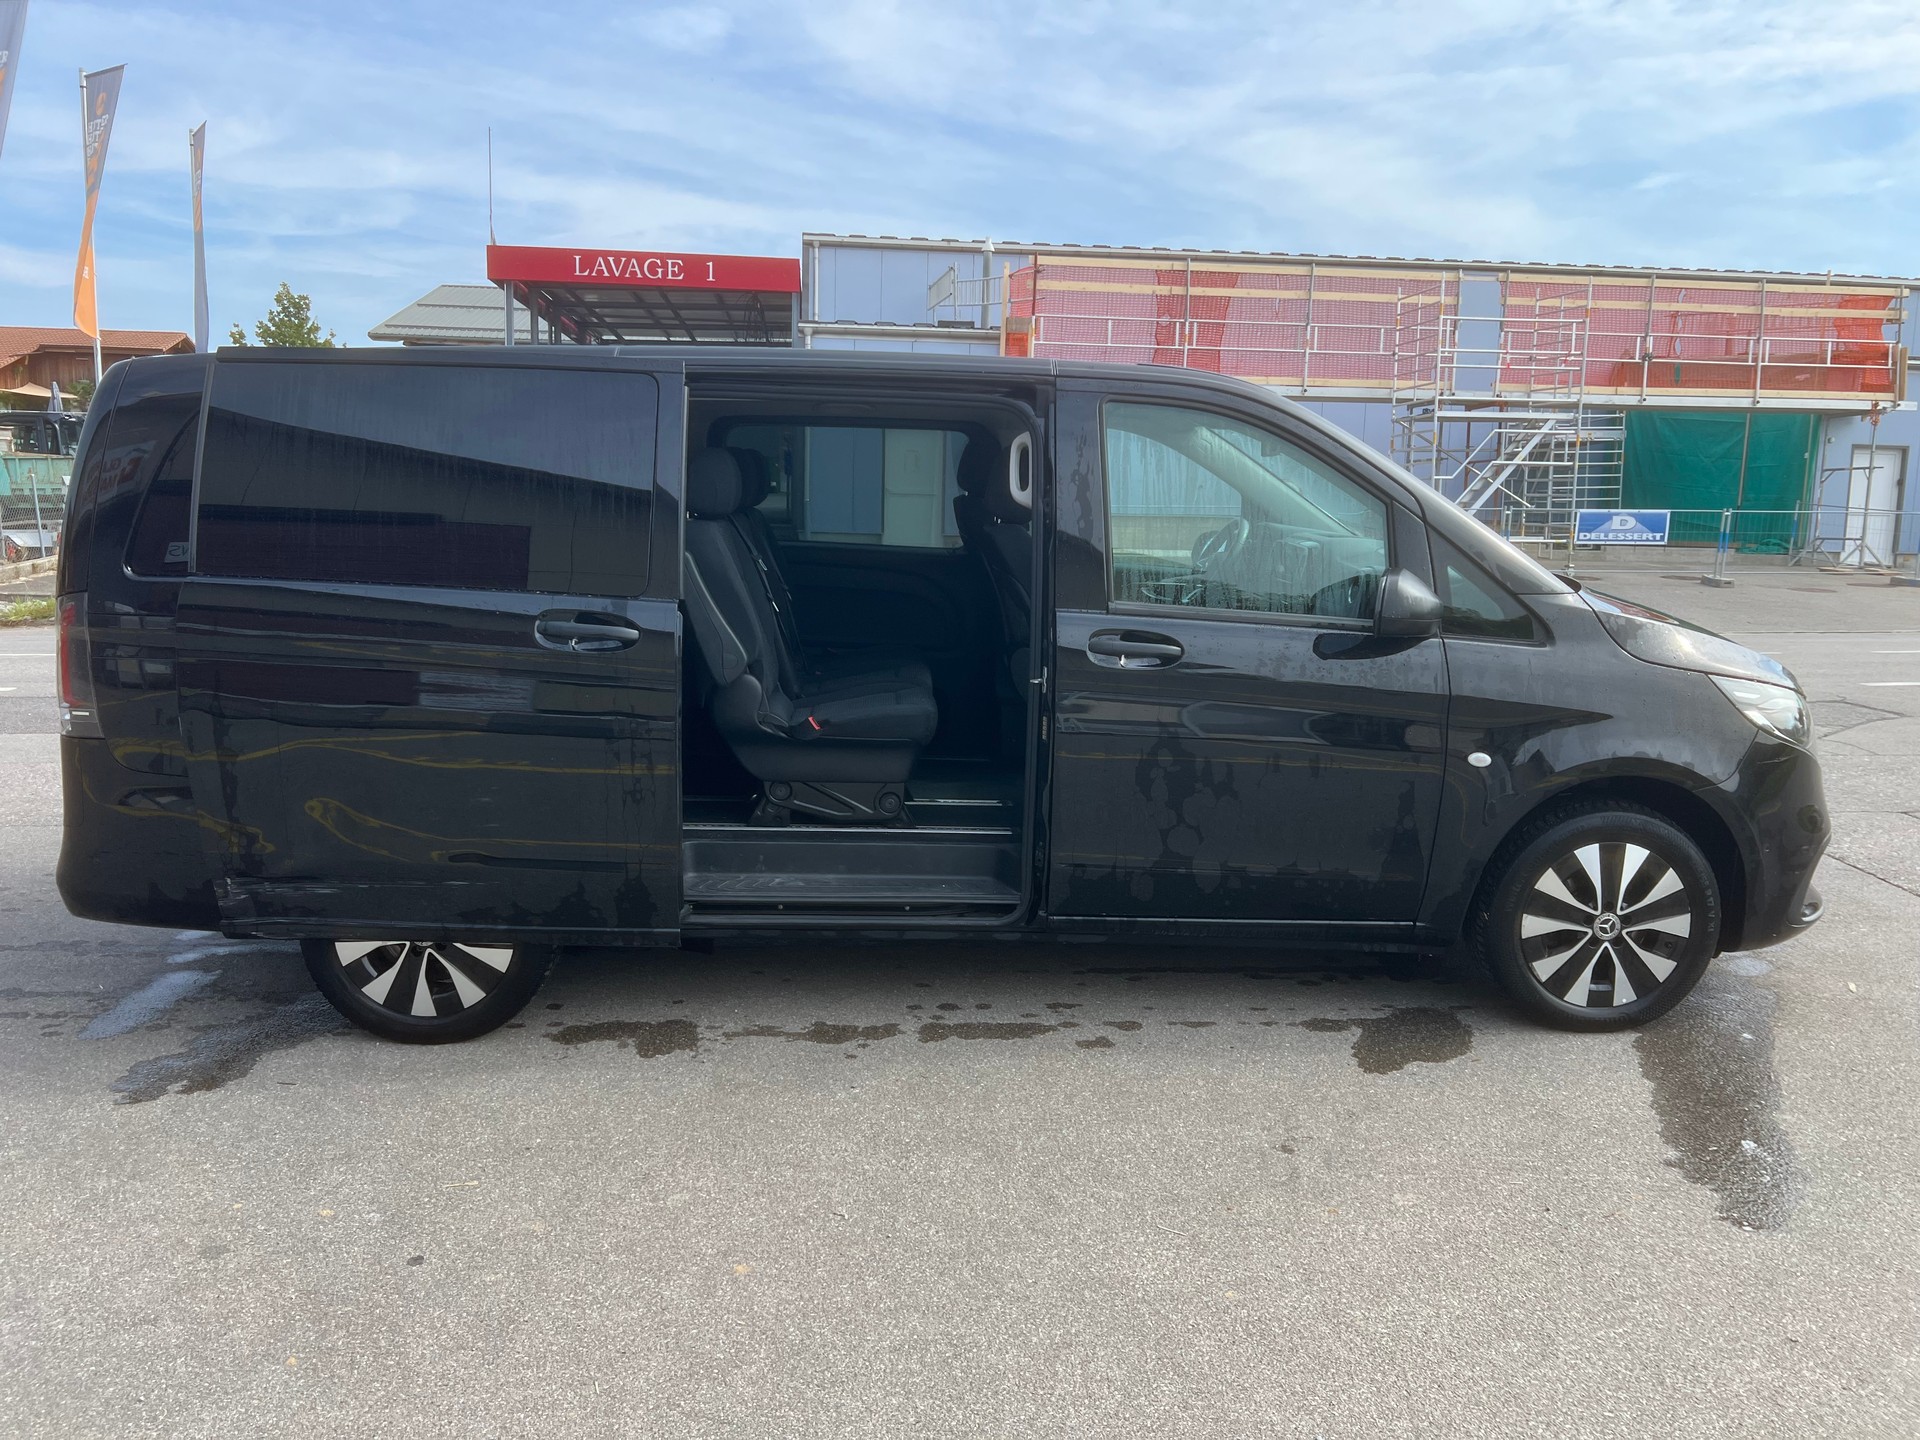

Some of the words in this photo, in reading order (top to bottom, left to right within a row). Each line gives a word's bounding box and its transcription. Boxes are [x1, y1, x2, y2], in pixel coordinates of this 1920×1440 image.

[573, 255, 685, 280] LAVAGE
[706, 261, 716, 282] 1
[1611, 515, 1637, 530] D
[1578, 532, 1664, 541] DELESSERT
